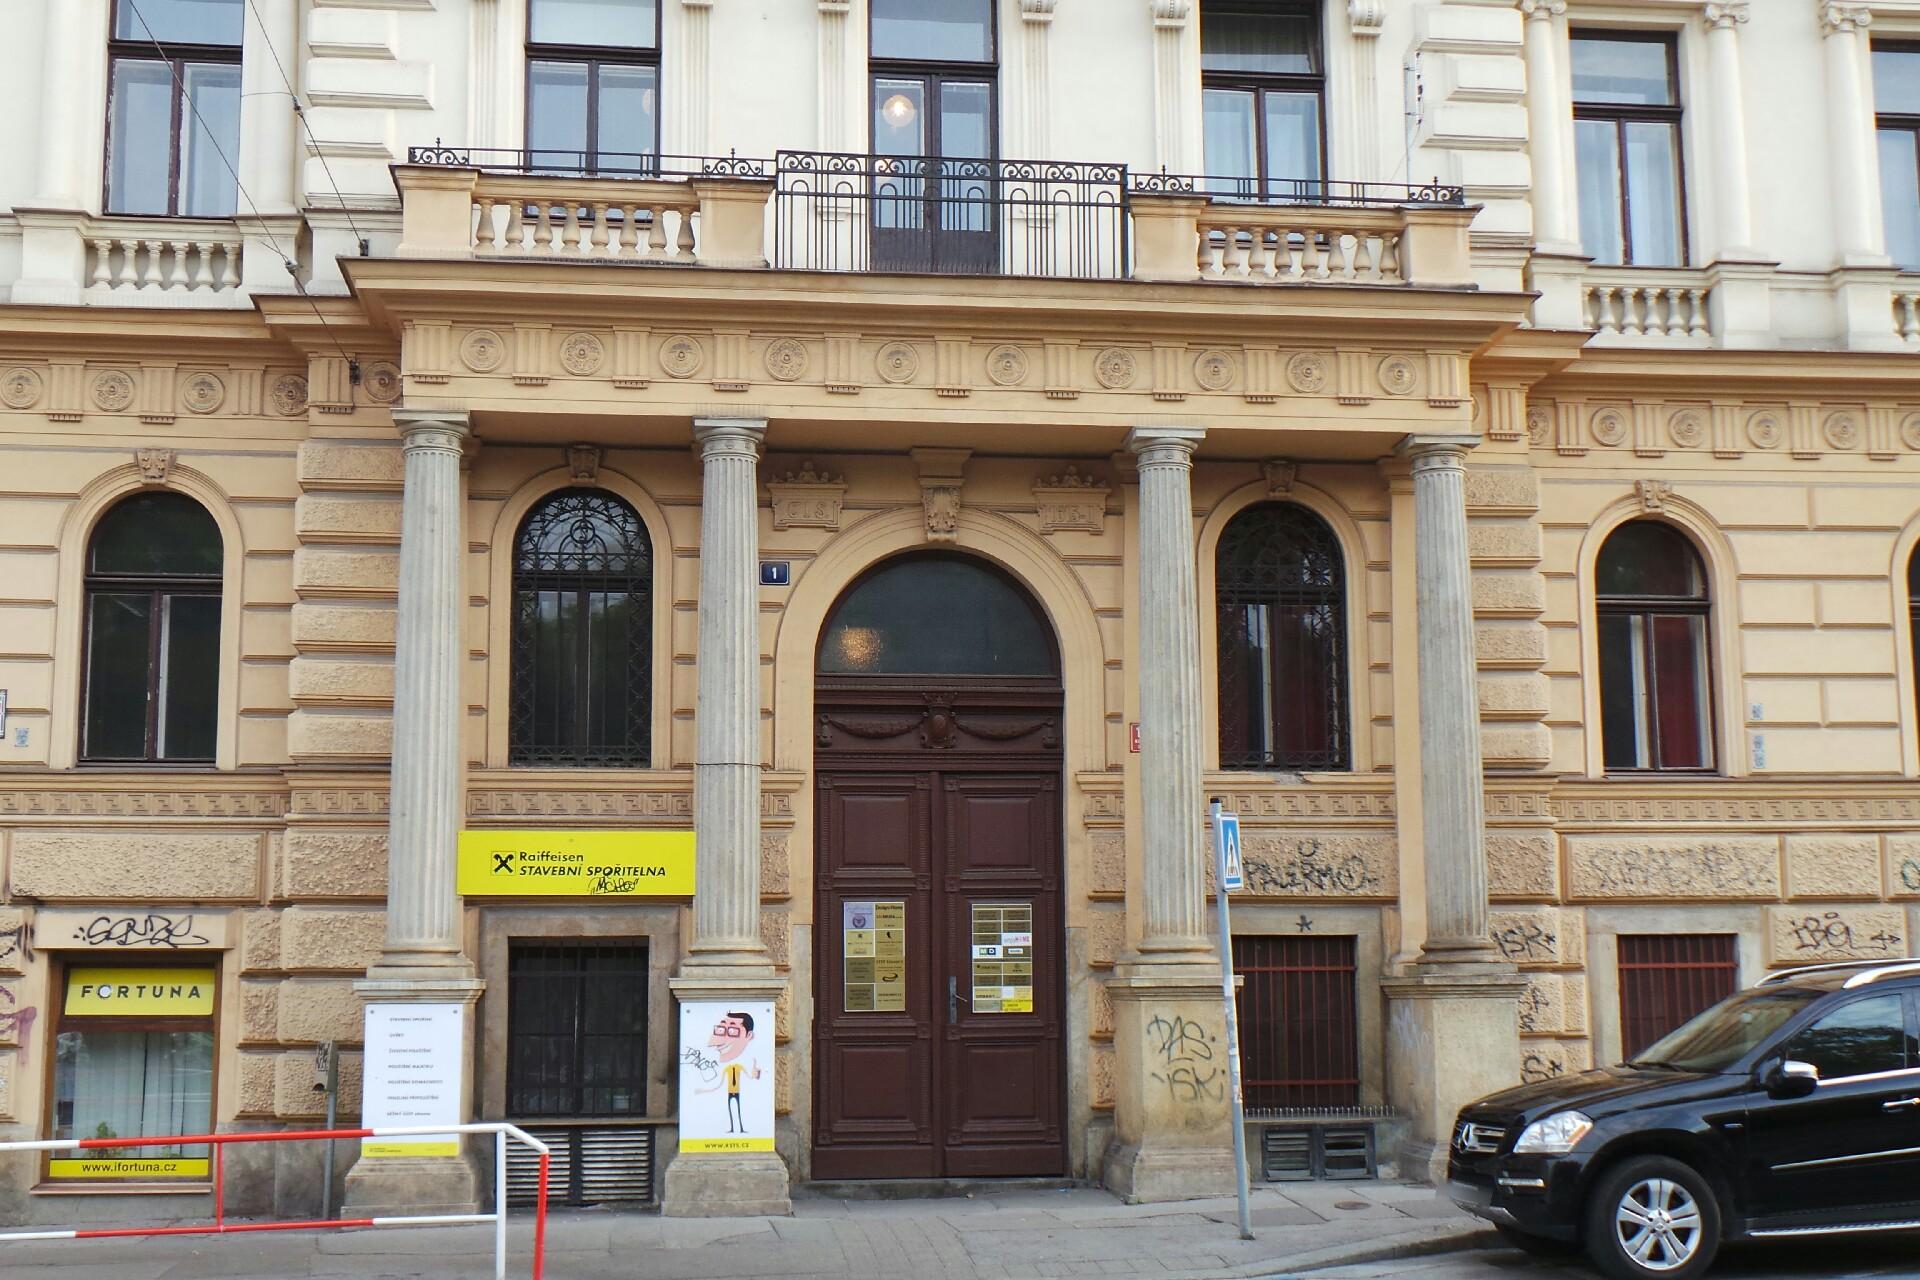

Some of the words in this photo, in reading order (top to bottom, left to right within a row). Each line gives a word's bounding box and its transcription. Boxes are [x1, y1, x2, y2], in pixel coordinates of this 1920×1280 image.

[772, 567, 777, 579] 1
[519, 851, 584, 862] Raiffeisen
[519, 864, 583, 876] STAVEBNÍ
[586, 864, 666, 877] SPOŘITELNA
[81, 985, 201, 998] FORTUNA
[81, 1162, 178, 1173] www.ifortuna.cz
